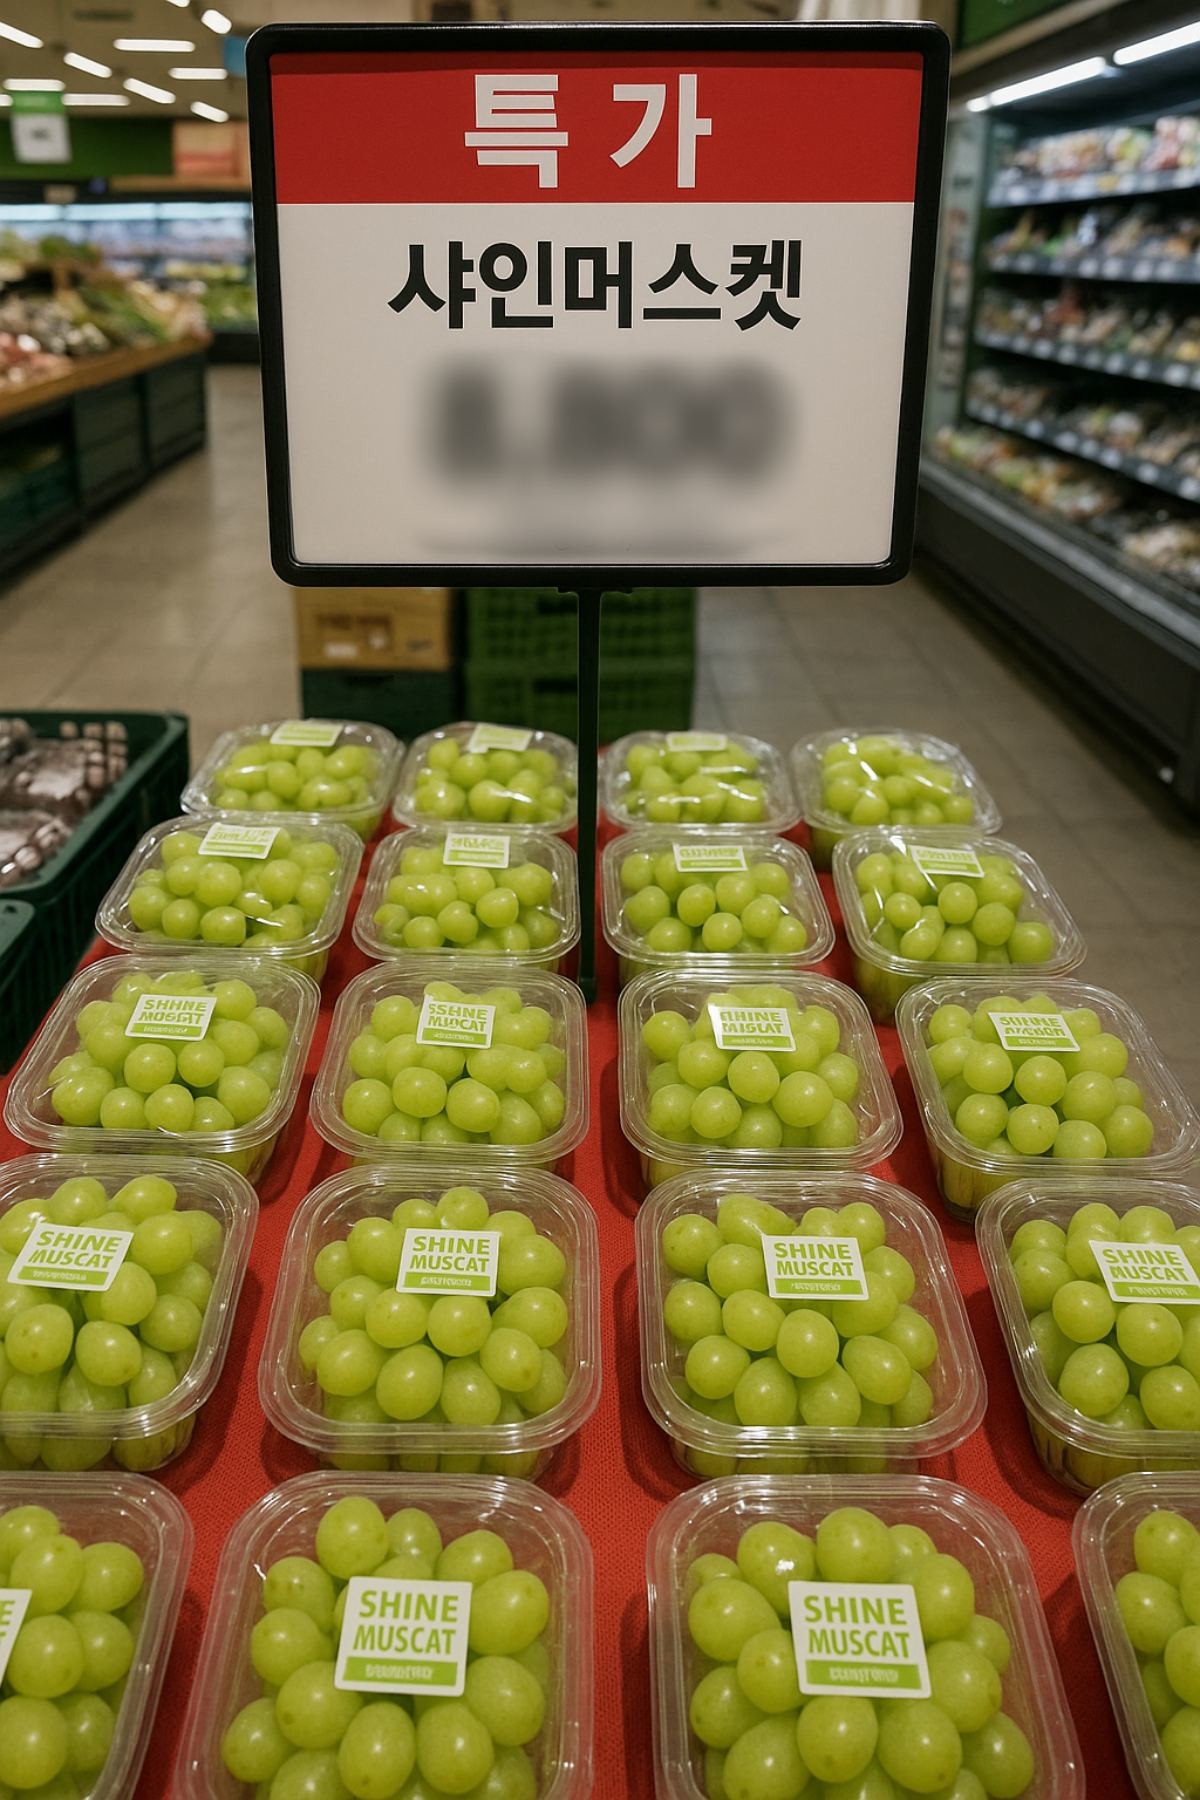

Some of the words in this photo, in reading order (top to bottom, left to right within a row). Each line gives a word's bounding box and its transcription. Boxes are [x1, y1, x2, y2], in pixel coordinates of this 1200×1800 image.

[387, 239, 802, 332] 샤인머스켓
[36, 1231, 122, 1253] SHINE
[412, 1236, 491, 1255] SHINE
[774, 1242, 852, 1260] SHINE
[28, 1249, 113, 1269] MUSCAT
[409, 1254, 490, 1273] MUSCAT
[1102, 1248, 1183, 1266] SHINE
[777, 1261, 854, 1277] MUSCAT
[1109, 1265, 1189, 1282] MUSCAT
[359, 1590, 459, 1623] SHINE
[804, 1595, 907, 1625] SHINE
[353, 1624, 456, 1655] MUSCAT
[808, 1628, 910, 1658] MUSCAT
